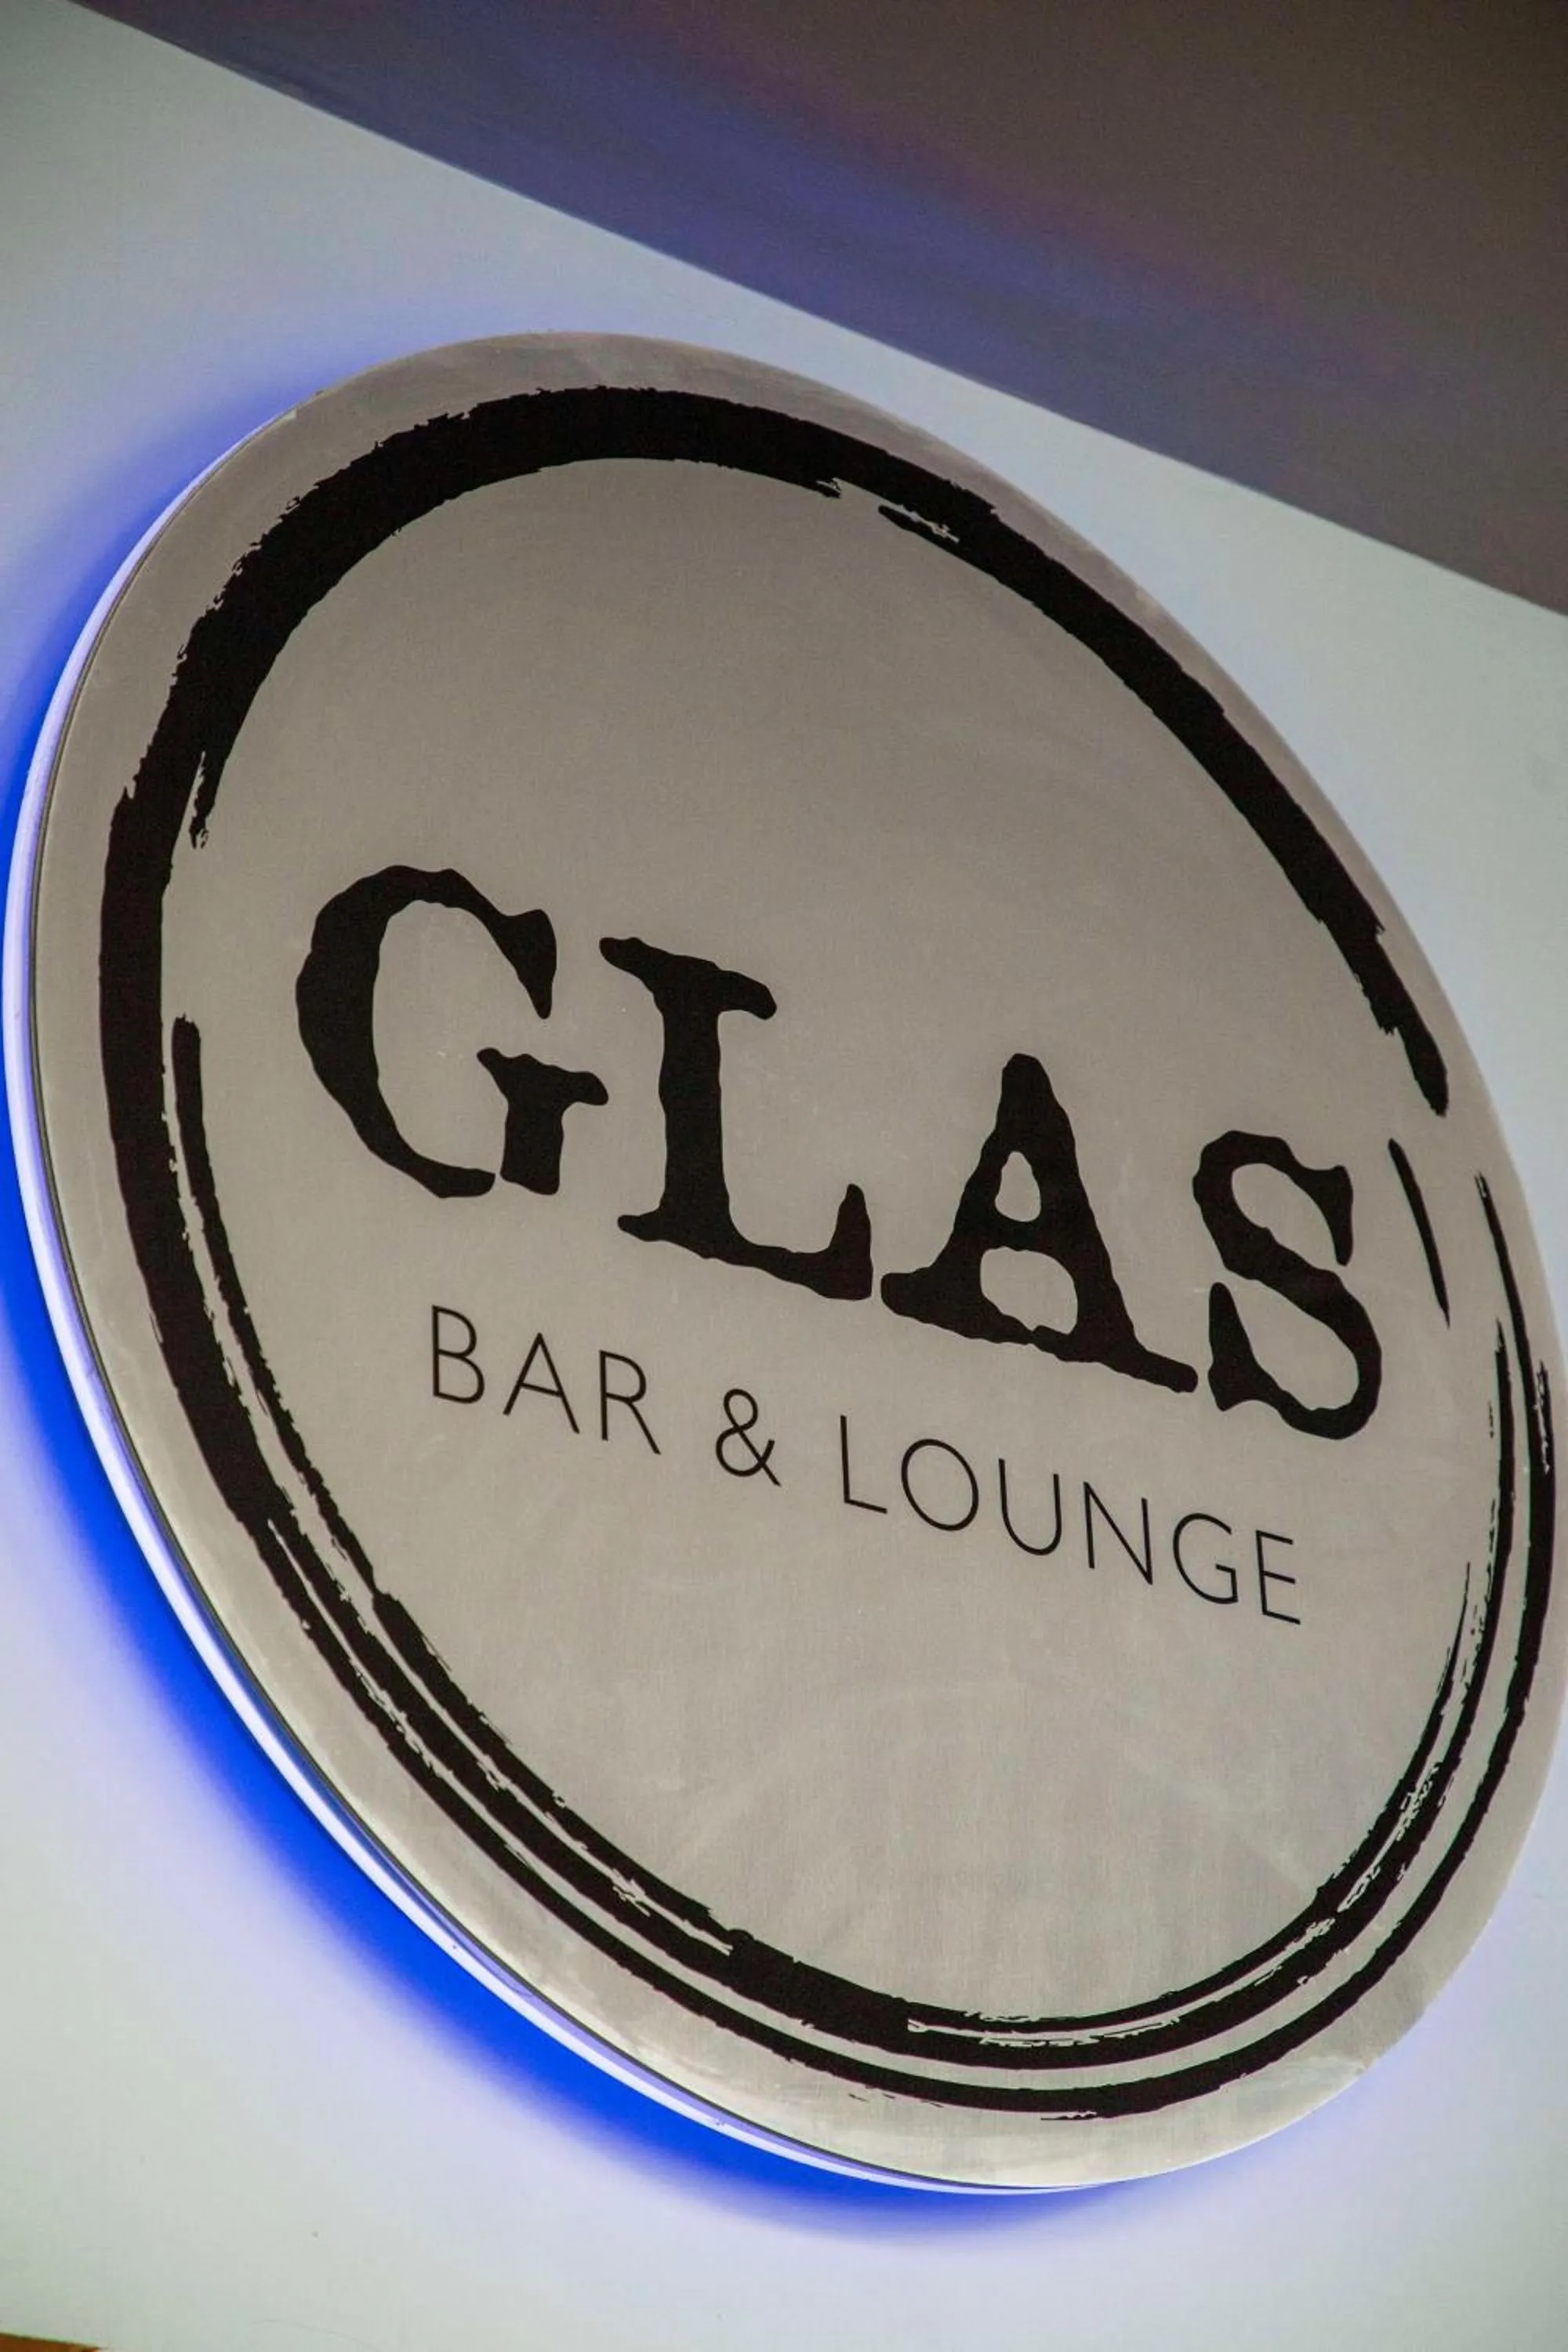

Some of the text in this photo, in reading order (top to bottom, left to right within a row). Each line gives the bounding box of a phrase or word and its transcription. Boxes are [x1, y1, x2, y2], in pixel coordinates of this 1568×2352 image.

[295, 865, 1382, 1440] GLAS
[430, 1304, 1301, 1626] BAR & LOUNGE
